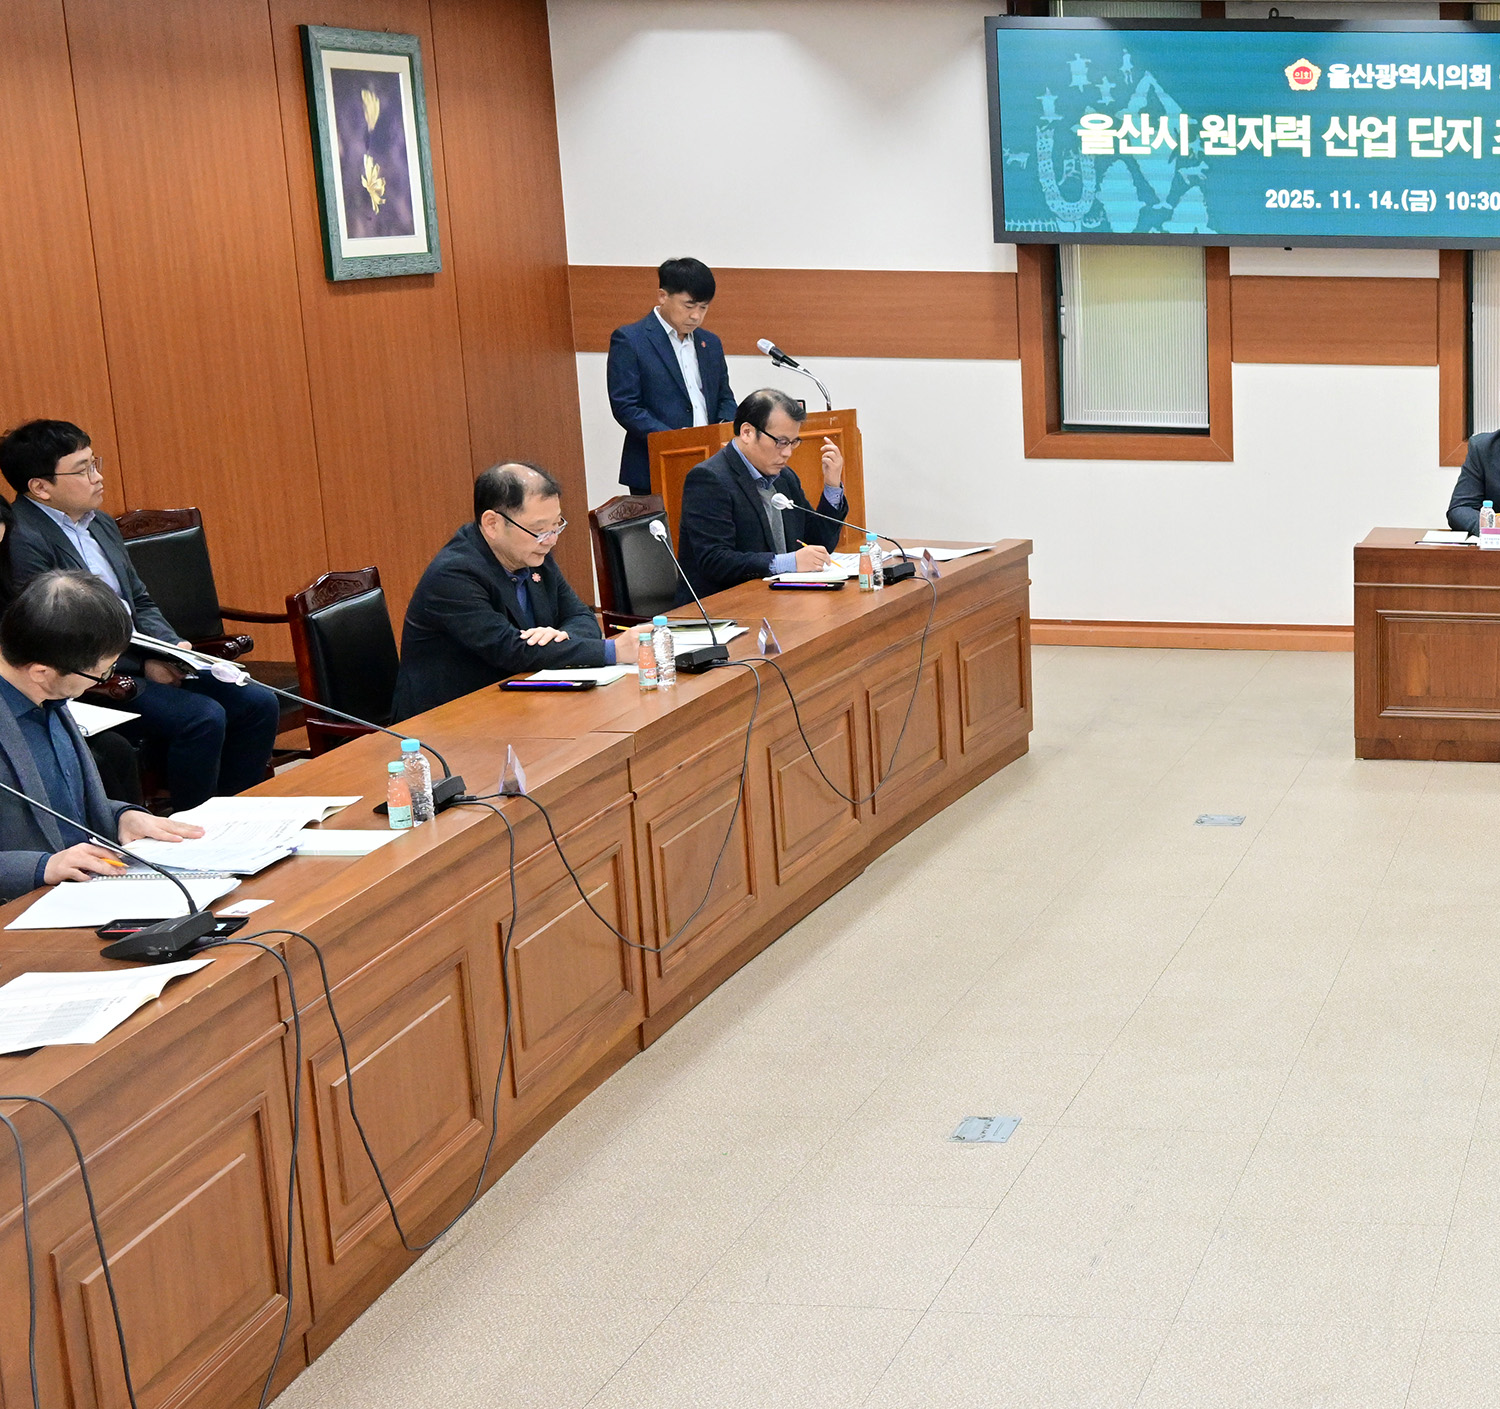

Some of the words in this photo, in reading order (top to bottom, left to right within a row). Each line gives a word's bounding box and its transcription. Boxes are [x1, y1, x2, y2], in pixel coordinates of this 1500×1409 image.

[1327, 63, 1491, 91] 울산광역시의회
[1076, 113, 1189, 156] 울산시
[1199, 114, 1311, 158] 원자력
[1321, 115, 1397, 158] 산업
[1408, 116, 1482, 159] 단지
[1265, 189, 1322, 209] 2025.
[1329, 190, 1361, 209] 11.
[1368, 189, 1437, 212] 14.(금)
